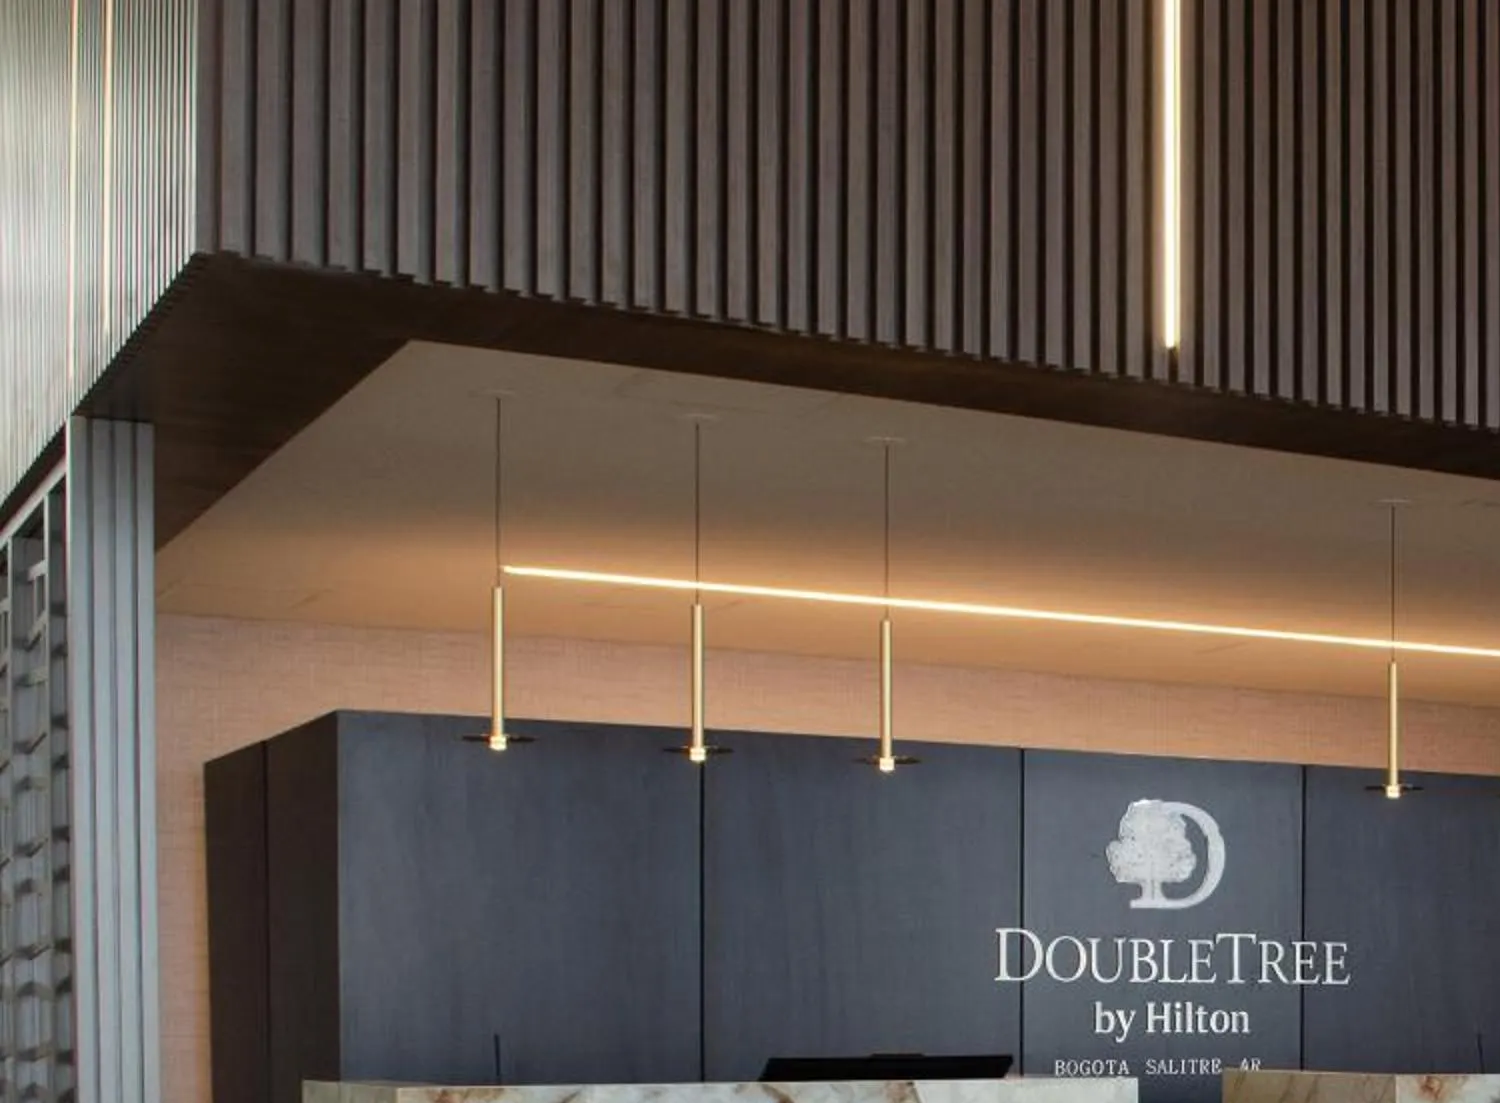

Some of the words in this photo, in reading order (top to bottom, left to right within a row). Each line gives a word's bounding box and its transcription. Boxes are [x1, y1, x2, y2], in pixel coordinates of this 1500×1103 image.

[1094, 1001, 1137, 1043] by
[1145, 1001, 1251, 1034] Hilton
[1054, 1059, 1131, 1077] BOGOTA
[1145, 1057, 1223, 1075] SALITRE
